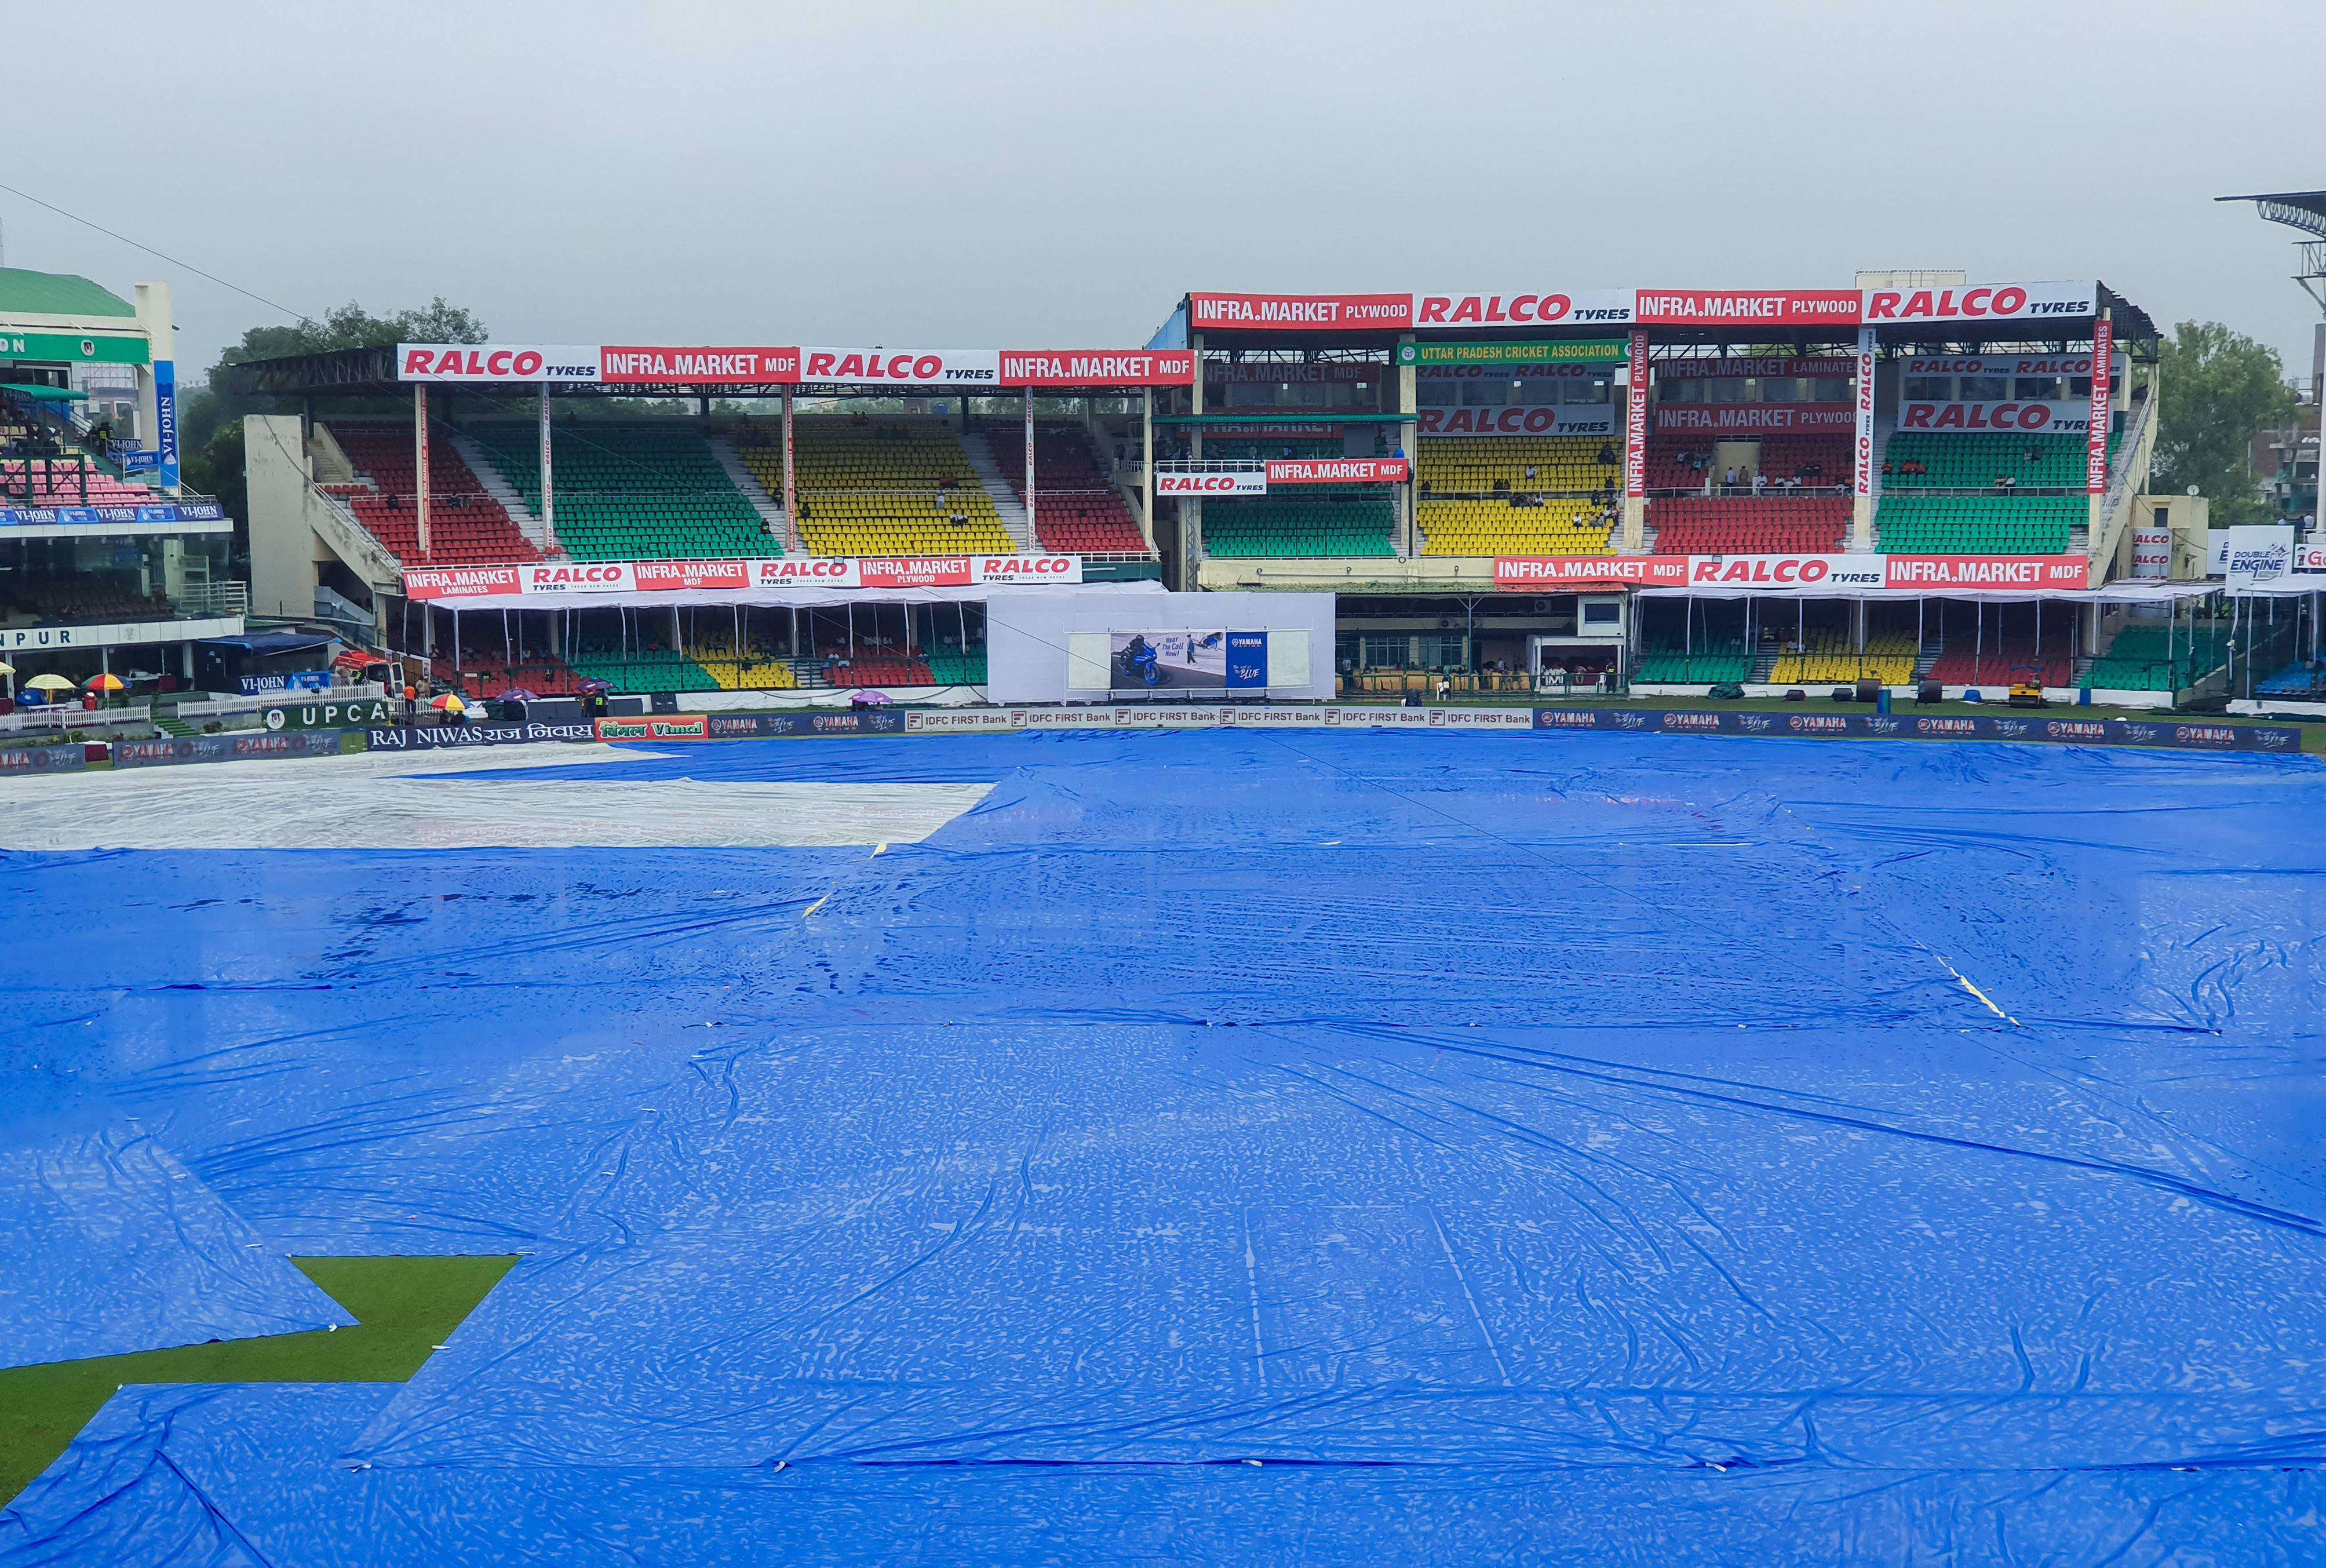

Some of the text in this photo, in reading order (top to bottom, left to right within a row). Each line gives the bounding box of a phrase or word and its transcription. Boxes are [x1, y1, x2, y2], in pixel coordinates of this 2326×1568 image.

[1418, 294, 1630, 322] RALCO TYRES
[1640, 297, 1857, 317] INFRA.MARKET PLYWOOD
[1868, 287, 2090, 318] RALCO TYRES
[1197, 300, 1408, 322] INFRA.MARKET PLYWOOD
[1421, 345, 1618, 359] UTTAR PRADESH CRICKET ASSOCIATION
[404, 349, 596, 377] RALCO TYRES
[606, 352, 796, 375] INFRA.MARKET MDF
[806, 353, 993, 379] RALCO TYRES
[1004, 356, 1190, 378] INFRA.MARKET MDF
[1515, 364, 1586, 377] RALCO
[1659, 358, 1788, 377] INFRA.MARKET
[1909, 360, 1982, 373] RALCO
[2015, 359, 2091, 373] RALCO
[1204, 364, 1361, 382] NFRA.MARKET MDF
[1861, 353, 1872, 410] RALCO
[1628, 334, 1646, 493] INFRA.MARKET PLYWOOD
[2089, 325, 2108, 490] INFRA.MARKET LAMINATES
[1416, 408, 1610, 432] RALCO TYRES
[1658, 409, 1795, 428] INFRA.MARKET
[1903, 403, 2051, 429] RALCO
[161, 396, 174, 454] VI-JOHN
[131, 455, 153, 464] VI-JOHN
[1858, 436, 1869, 494] RALCO
[1271, 463, 1402, 480] INFRA.MARKET MDF
[1160, 477, 1234, 491] RALCO
[15, 510, 55, 522] VI-JOHN
[96, 508, 135, 520] VI-JOHN
[180, 505, 217, 517] VI-JOHN
[637, 563, 743, 579] INFRA.MARKET
[761, 562, 847, 577] RALCO
[863, 559, 967, 575] INFRA.MARKET
[984, 559, 1070, 573] RALCO
[1499, 561, 1684, 578] INFRA.MARKET MDF
[1693, 559, 1880, 582] RALCO TYRES
[1891, 562, 2083, 582] INFRA.MARKET MDF
[2230, 559, 2284, 578] ENGINE
[407, 570, 514, 588] INFRA.MARKET
[533, 567, 622, 583] RALCO
[897, 574, 935, 584] PLYWOOD
[441, 586, 488, 595] LAMINATES
[1239, 669, 1260, 680] BLUE
[240, 676, 285, 692] VI-JOHN
[721, 717, 757, 729] YAMAHA
[824, 716, 858, 727] YAMAHA
[925, 715, 1007, 725] IDFC FIRST Bank
[1029, 713, 1111, 723] IDFC FIRST Bank
[1133, 712, 1215, 721] IDFC FIRST Bank
[1238, 712, 1320, 721] IDFC FIRST Bank
[1343, 713, 1424, 722] IDFC FIRST Bank
[1448, 714, 1530, 724] IDFC FIRST Bank
[1554, 712, 1596, 723] YAMAHA
[1677, 714, 1719, 725] YAMAHA
[1803, 717, 1846, 728] YAMAHA
[483, 723, 593, 739] राज निवास
[651, 722, 703, 735] Vimal
[1931, 719, 1975, 731] YAMAHA
[2060, 722, 2104, 735] YAMAHA
[371, 727, 483, 747] RAJ NIWAS
[2189, 728, 2234, 740] YAMAHA
